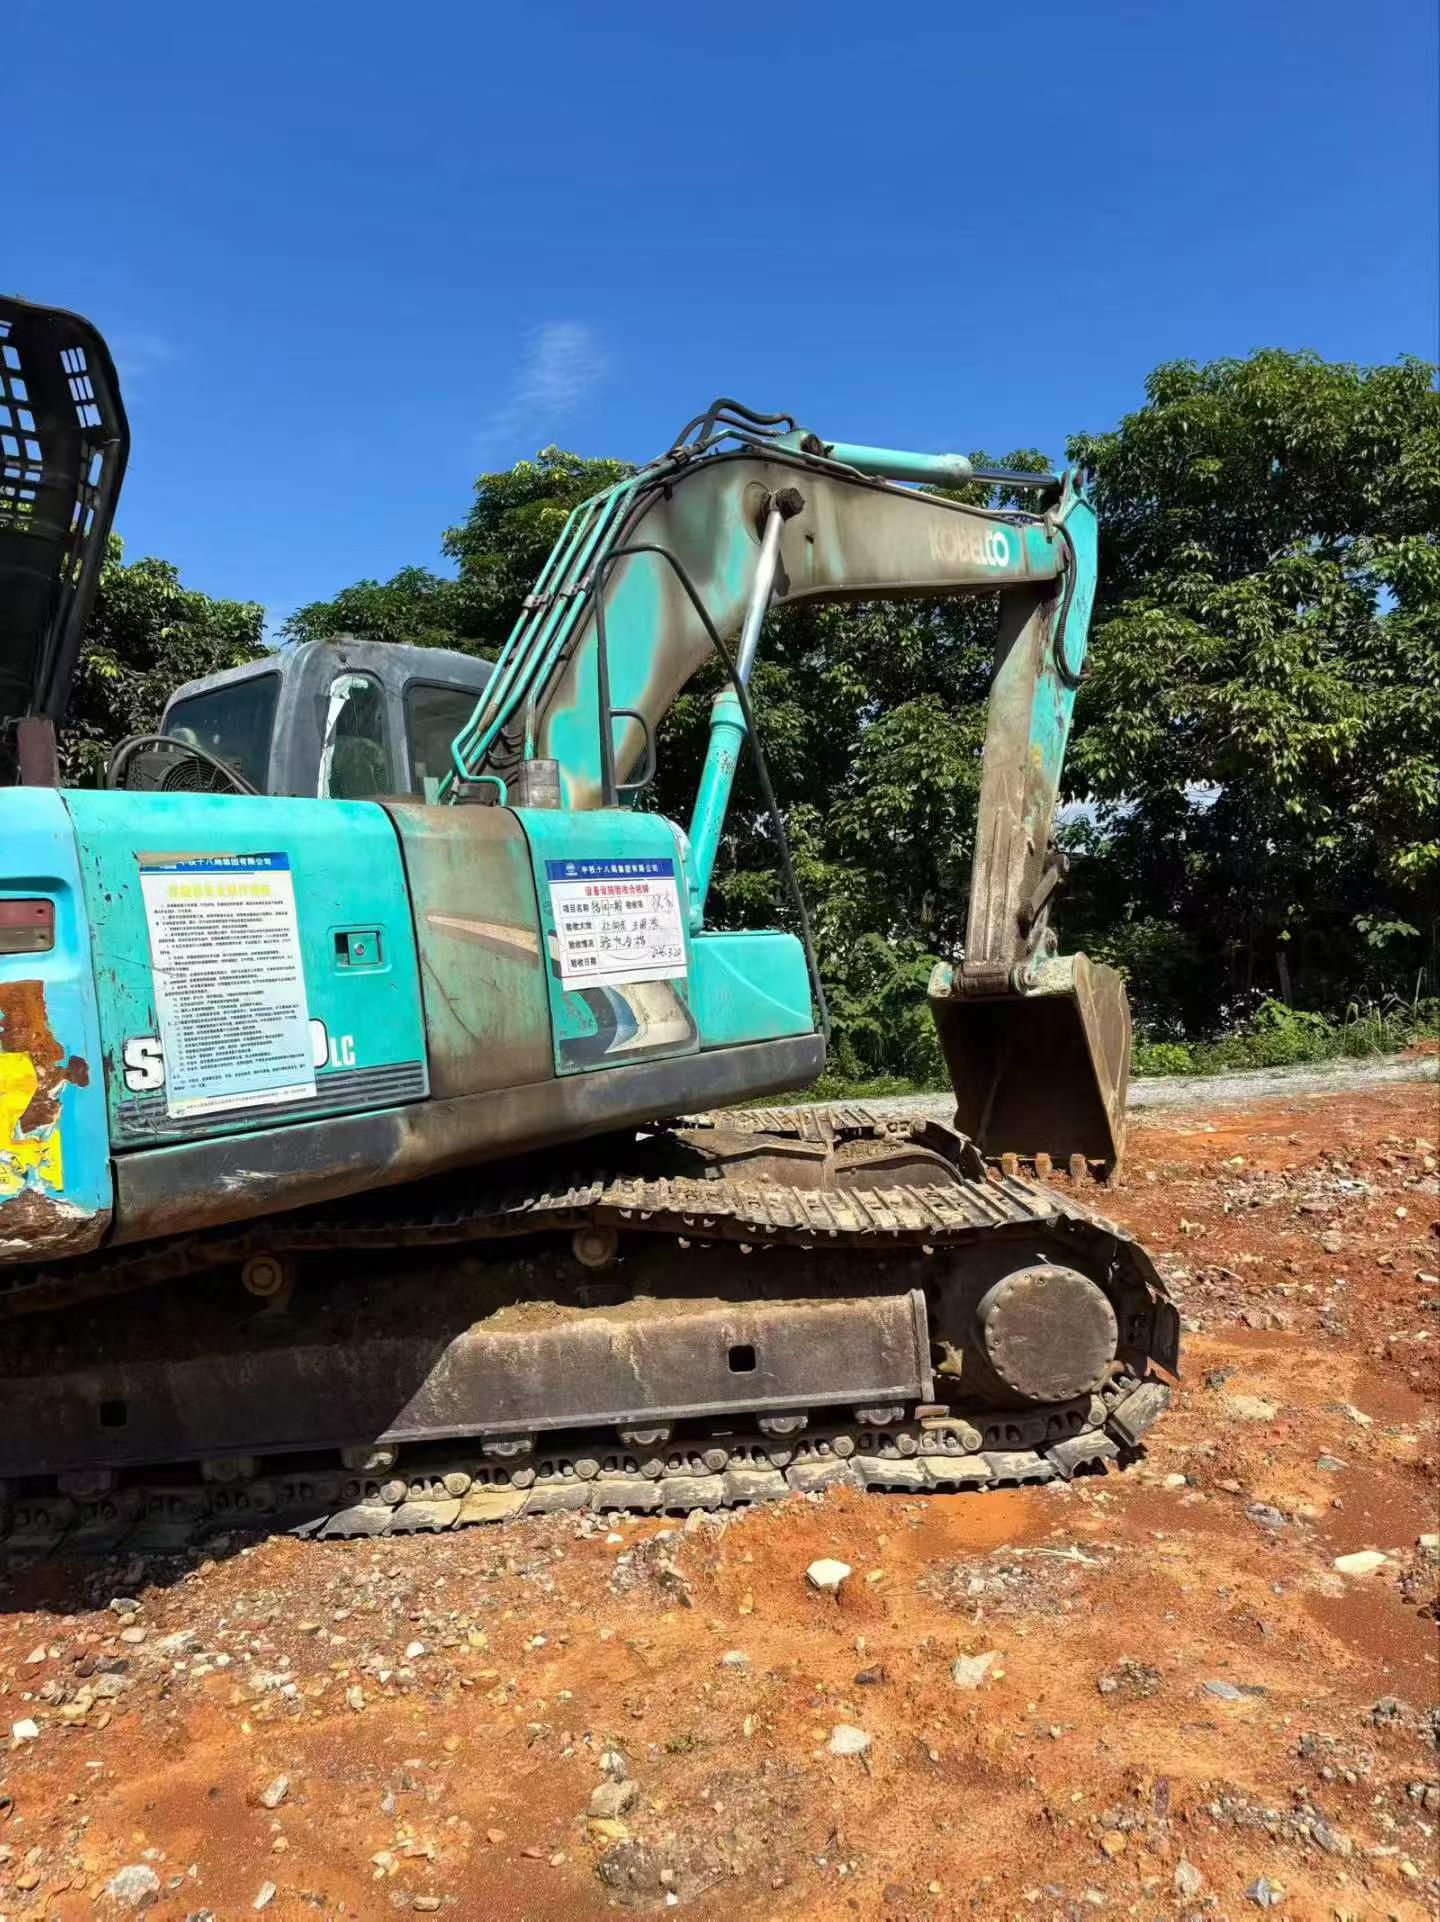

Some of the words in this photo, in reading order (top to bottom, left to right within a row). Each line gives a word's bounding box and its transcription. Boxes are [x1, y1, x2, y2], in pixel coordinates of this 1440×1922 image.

[928, 525, 1009, 567] KOBELCO
[581, 863, 659, 874] 中铁十八局集团有限公司
[562, 902, 589, 913] 项目名称
[570, 956, 597, 968] 验收日期
